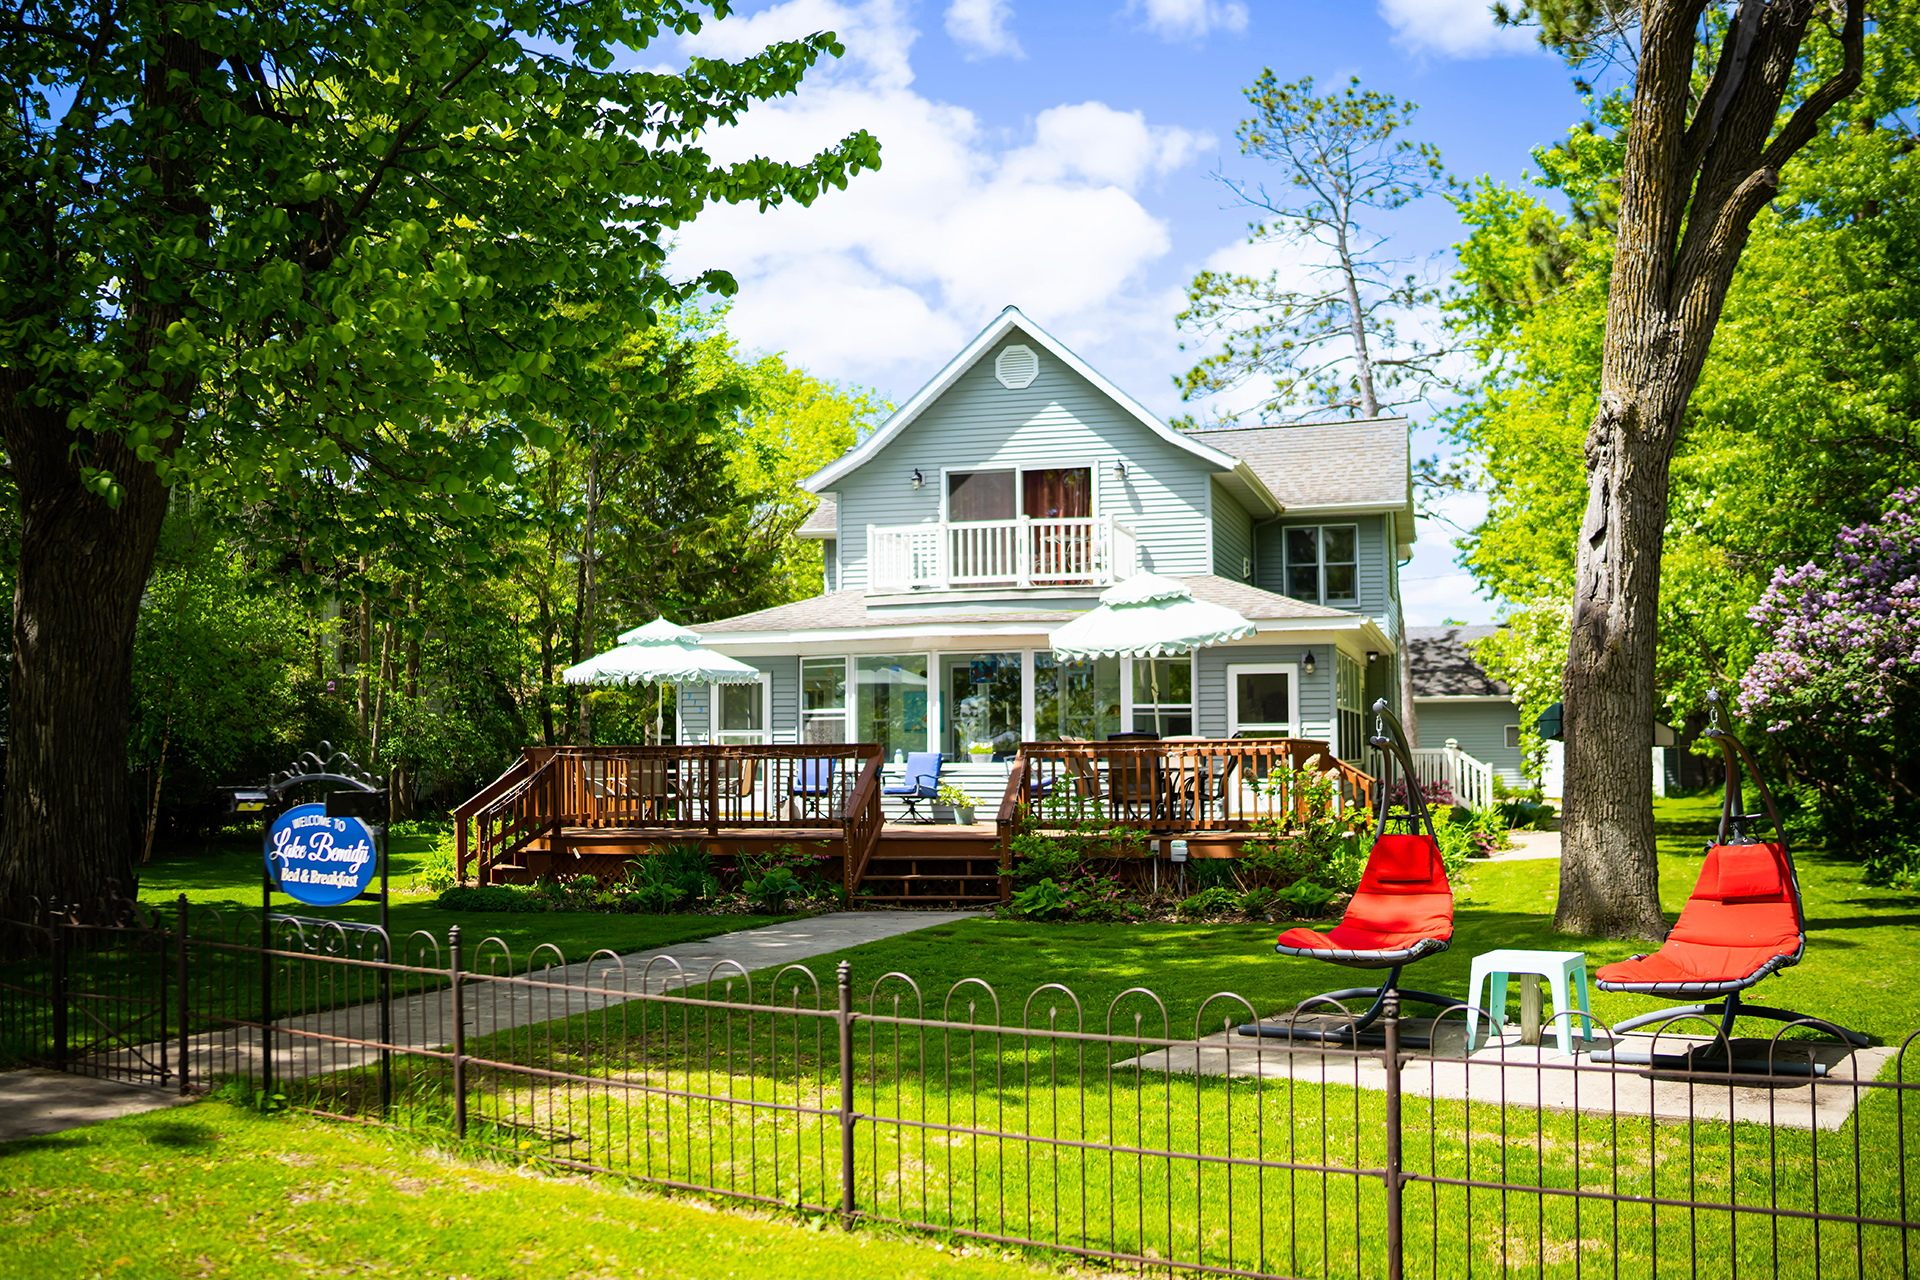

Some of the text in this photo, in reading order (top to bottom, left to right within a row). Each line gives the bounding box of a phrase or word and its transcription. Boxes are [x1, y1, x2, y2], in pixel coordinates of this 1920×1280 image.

[291, 815, 346, 832] WELCOME TO
[269, 827, 370, 874] Lake Bemidji
[281, 868, 359, 889] Bed & Breakfast
